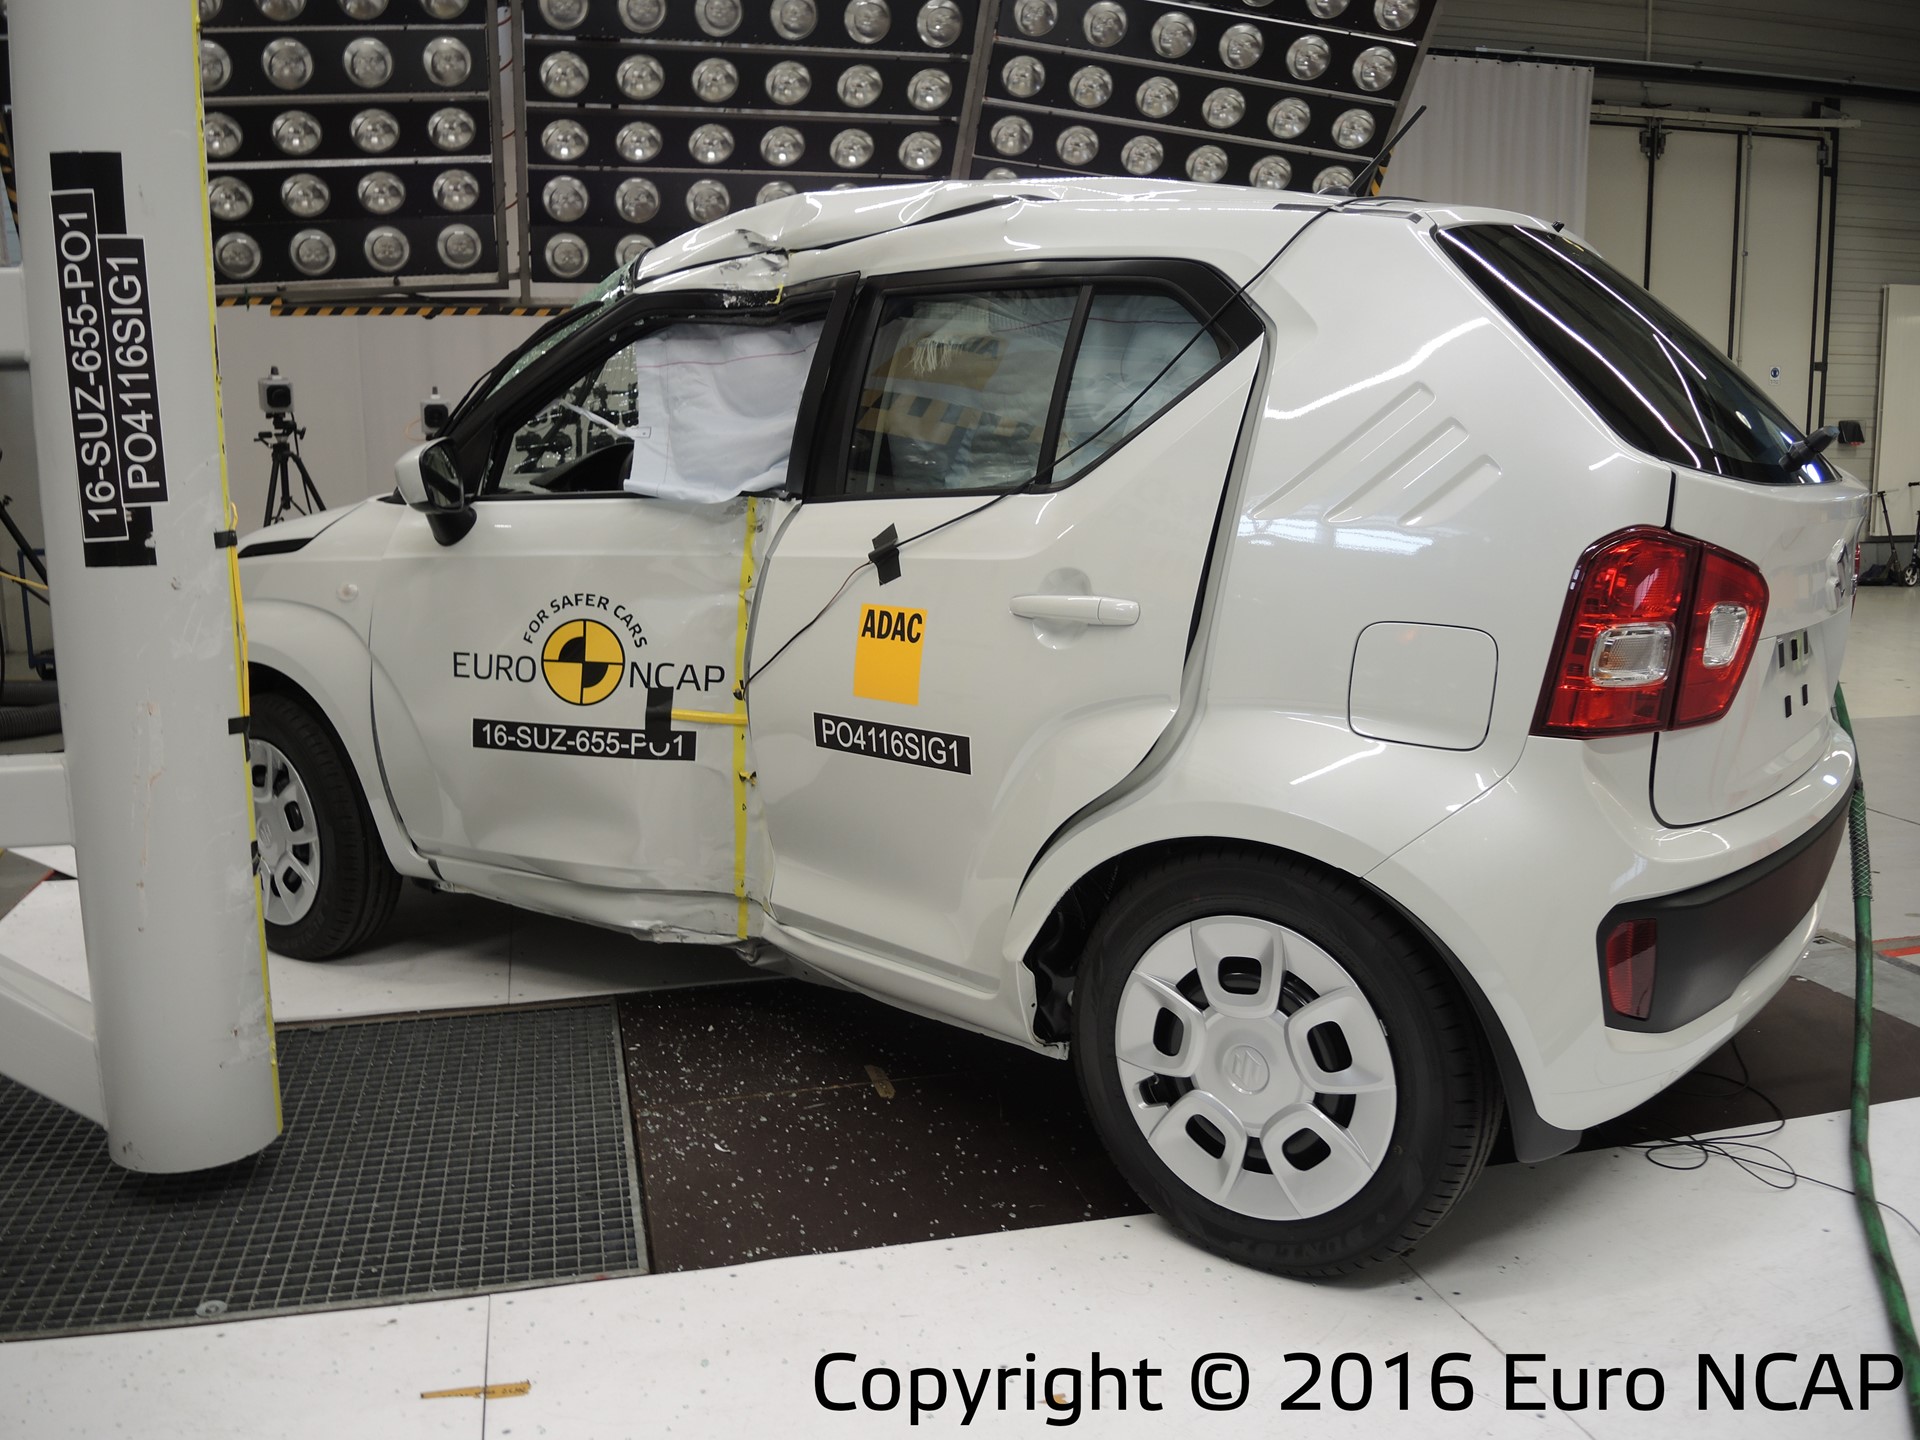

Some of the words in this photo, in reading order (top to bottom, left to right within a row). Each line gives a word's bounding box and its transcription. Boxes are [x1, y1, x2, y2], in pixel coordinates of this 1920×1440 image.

[57, 211, 118, 523] 16-SUZ-655-PO1
[105, 256, 161, 490] PO4116SIG1
[522, 609, 550, 645] FOR
[550, 592, 610, 614] SAFER
[612, 604, 648, 649] CARS
[861, 609, 923, 644] ADAC
[452, 651, 537, 683] EURO
[628, 661, 726, 692] NCAP
[821, 718, 959, 768] PO4116SIG1
